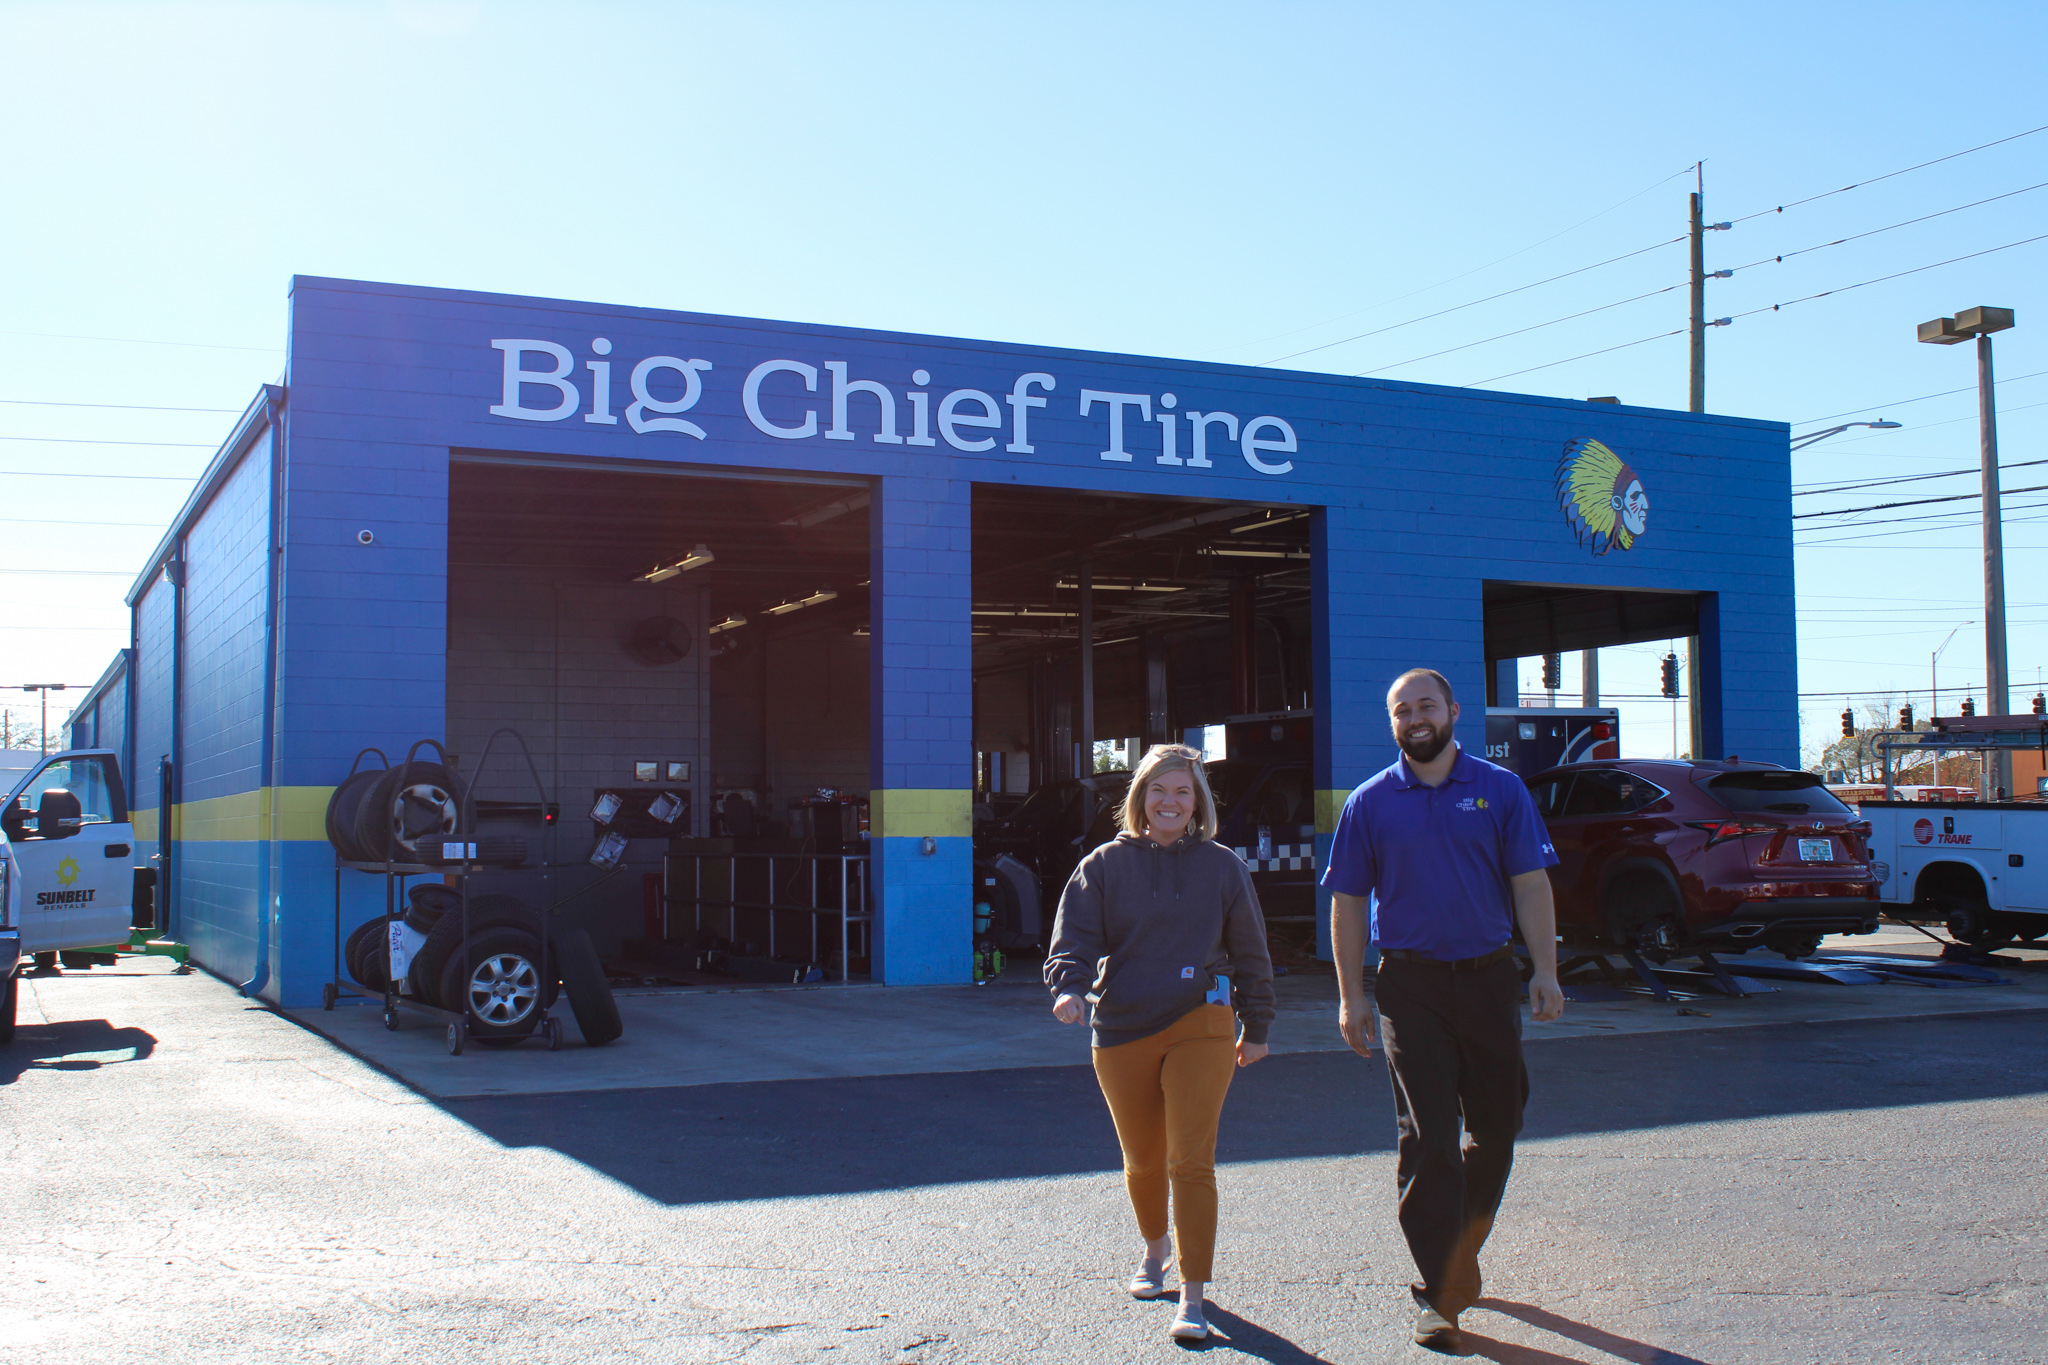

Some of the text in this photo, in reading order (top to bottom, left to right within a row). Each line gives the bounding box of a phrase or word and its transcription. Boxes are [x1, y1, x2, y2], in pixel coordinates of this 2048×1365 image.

[489, 337, 1298, 475] Big Chief Tire
[1486, 741, 1509, 758] ust
[1937, 833, 1973, 845] TRANE
[37, 889, 96, 905] SUNBELT
[43, 902, 87, 911] RENTALS
